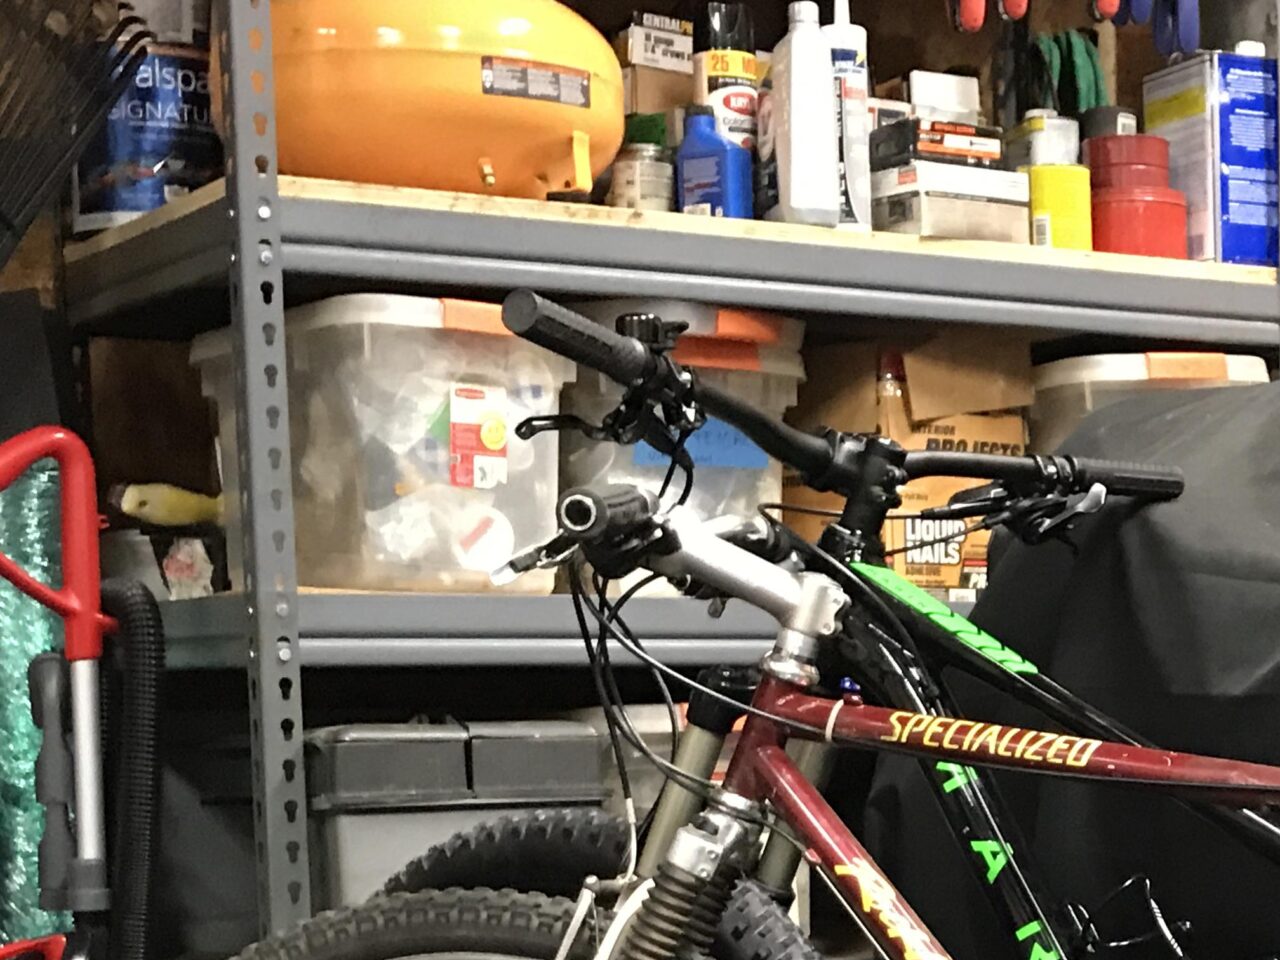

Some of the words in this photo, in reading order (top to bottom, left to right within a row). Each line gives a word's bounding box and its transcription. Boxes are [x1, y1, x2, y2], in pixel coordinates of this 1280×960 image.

[906, 518, 966, 543] LIQUID
[906, 541, 961, 565] NAILS
[881, 711, 1102, 768] SPECIALIZED
